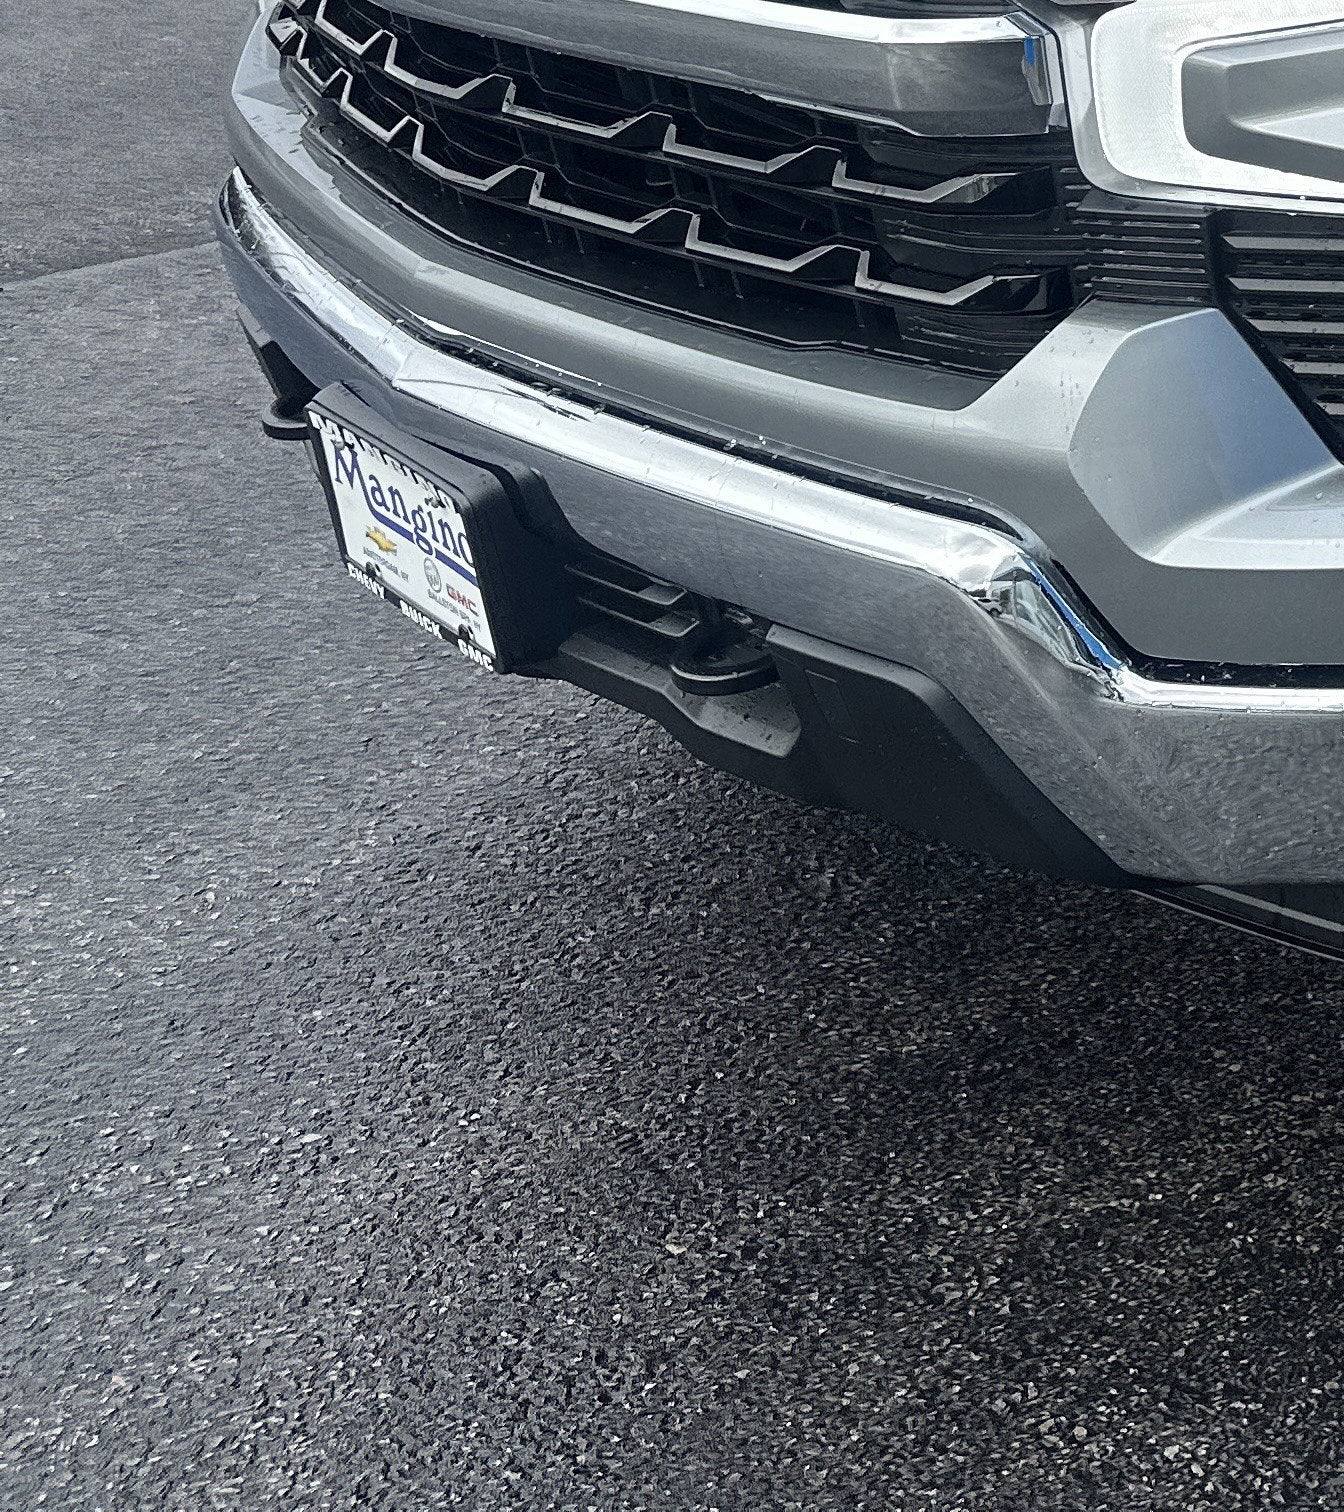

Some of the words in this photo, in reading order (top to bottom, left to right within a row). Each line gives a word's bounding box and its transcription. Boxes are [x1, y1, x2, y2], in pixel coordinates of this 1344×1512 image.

[330, 439, 475, 568] Mangino
[347, 562, 385, 600] CHEVY
[400, 599, 443, 640] BUICK
[458, 638, 494, 672] GMC
[446, 583, 479, 617] GMC
